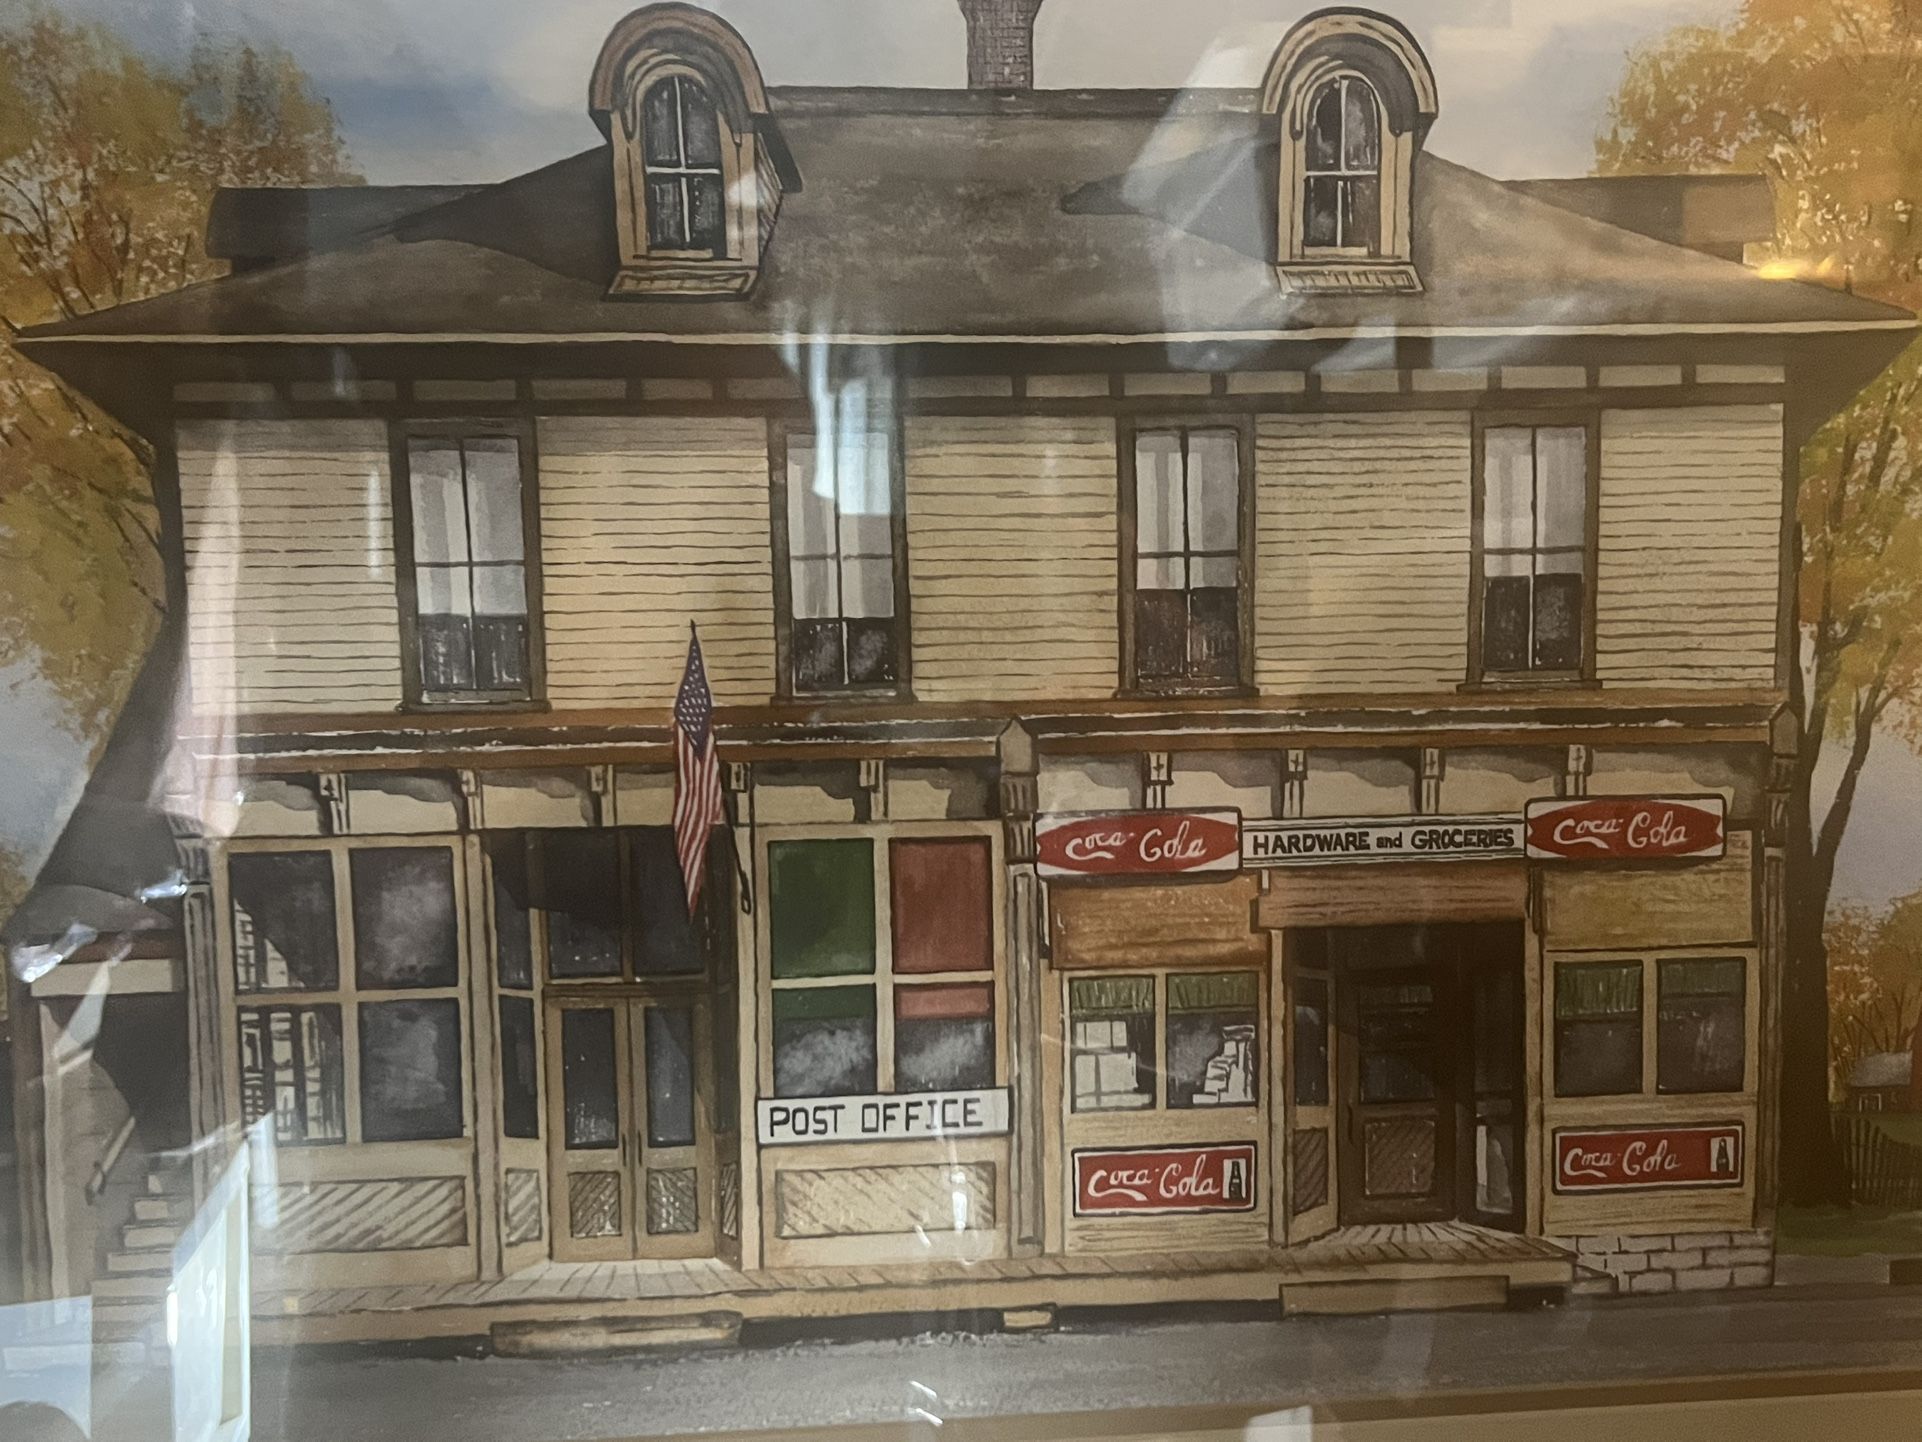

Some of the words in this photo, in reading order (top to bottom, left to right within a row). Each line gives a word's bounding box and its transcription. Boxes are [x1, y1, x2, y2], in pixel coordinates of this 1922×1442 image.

[1253, 831, 1371, 855] HARDWARE
[1376, 831, 1403, 849] and
[1411, 828, 1515, 850] GROCERIES
[769, 1104, 846, 1137] POST
[861, 1098, 983, 1132] OFFICE
